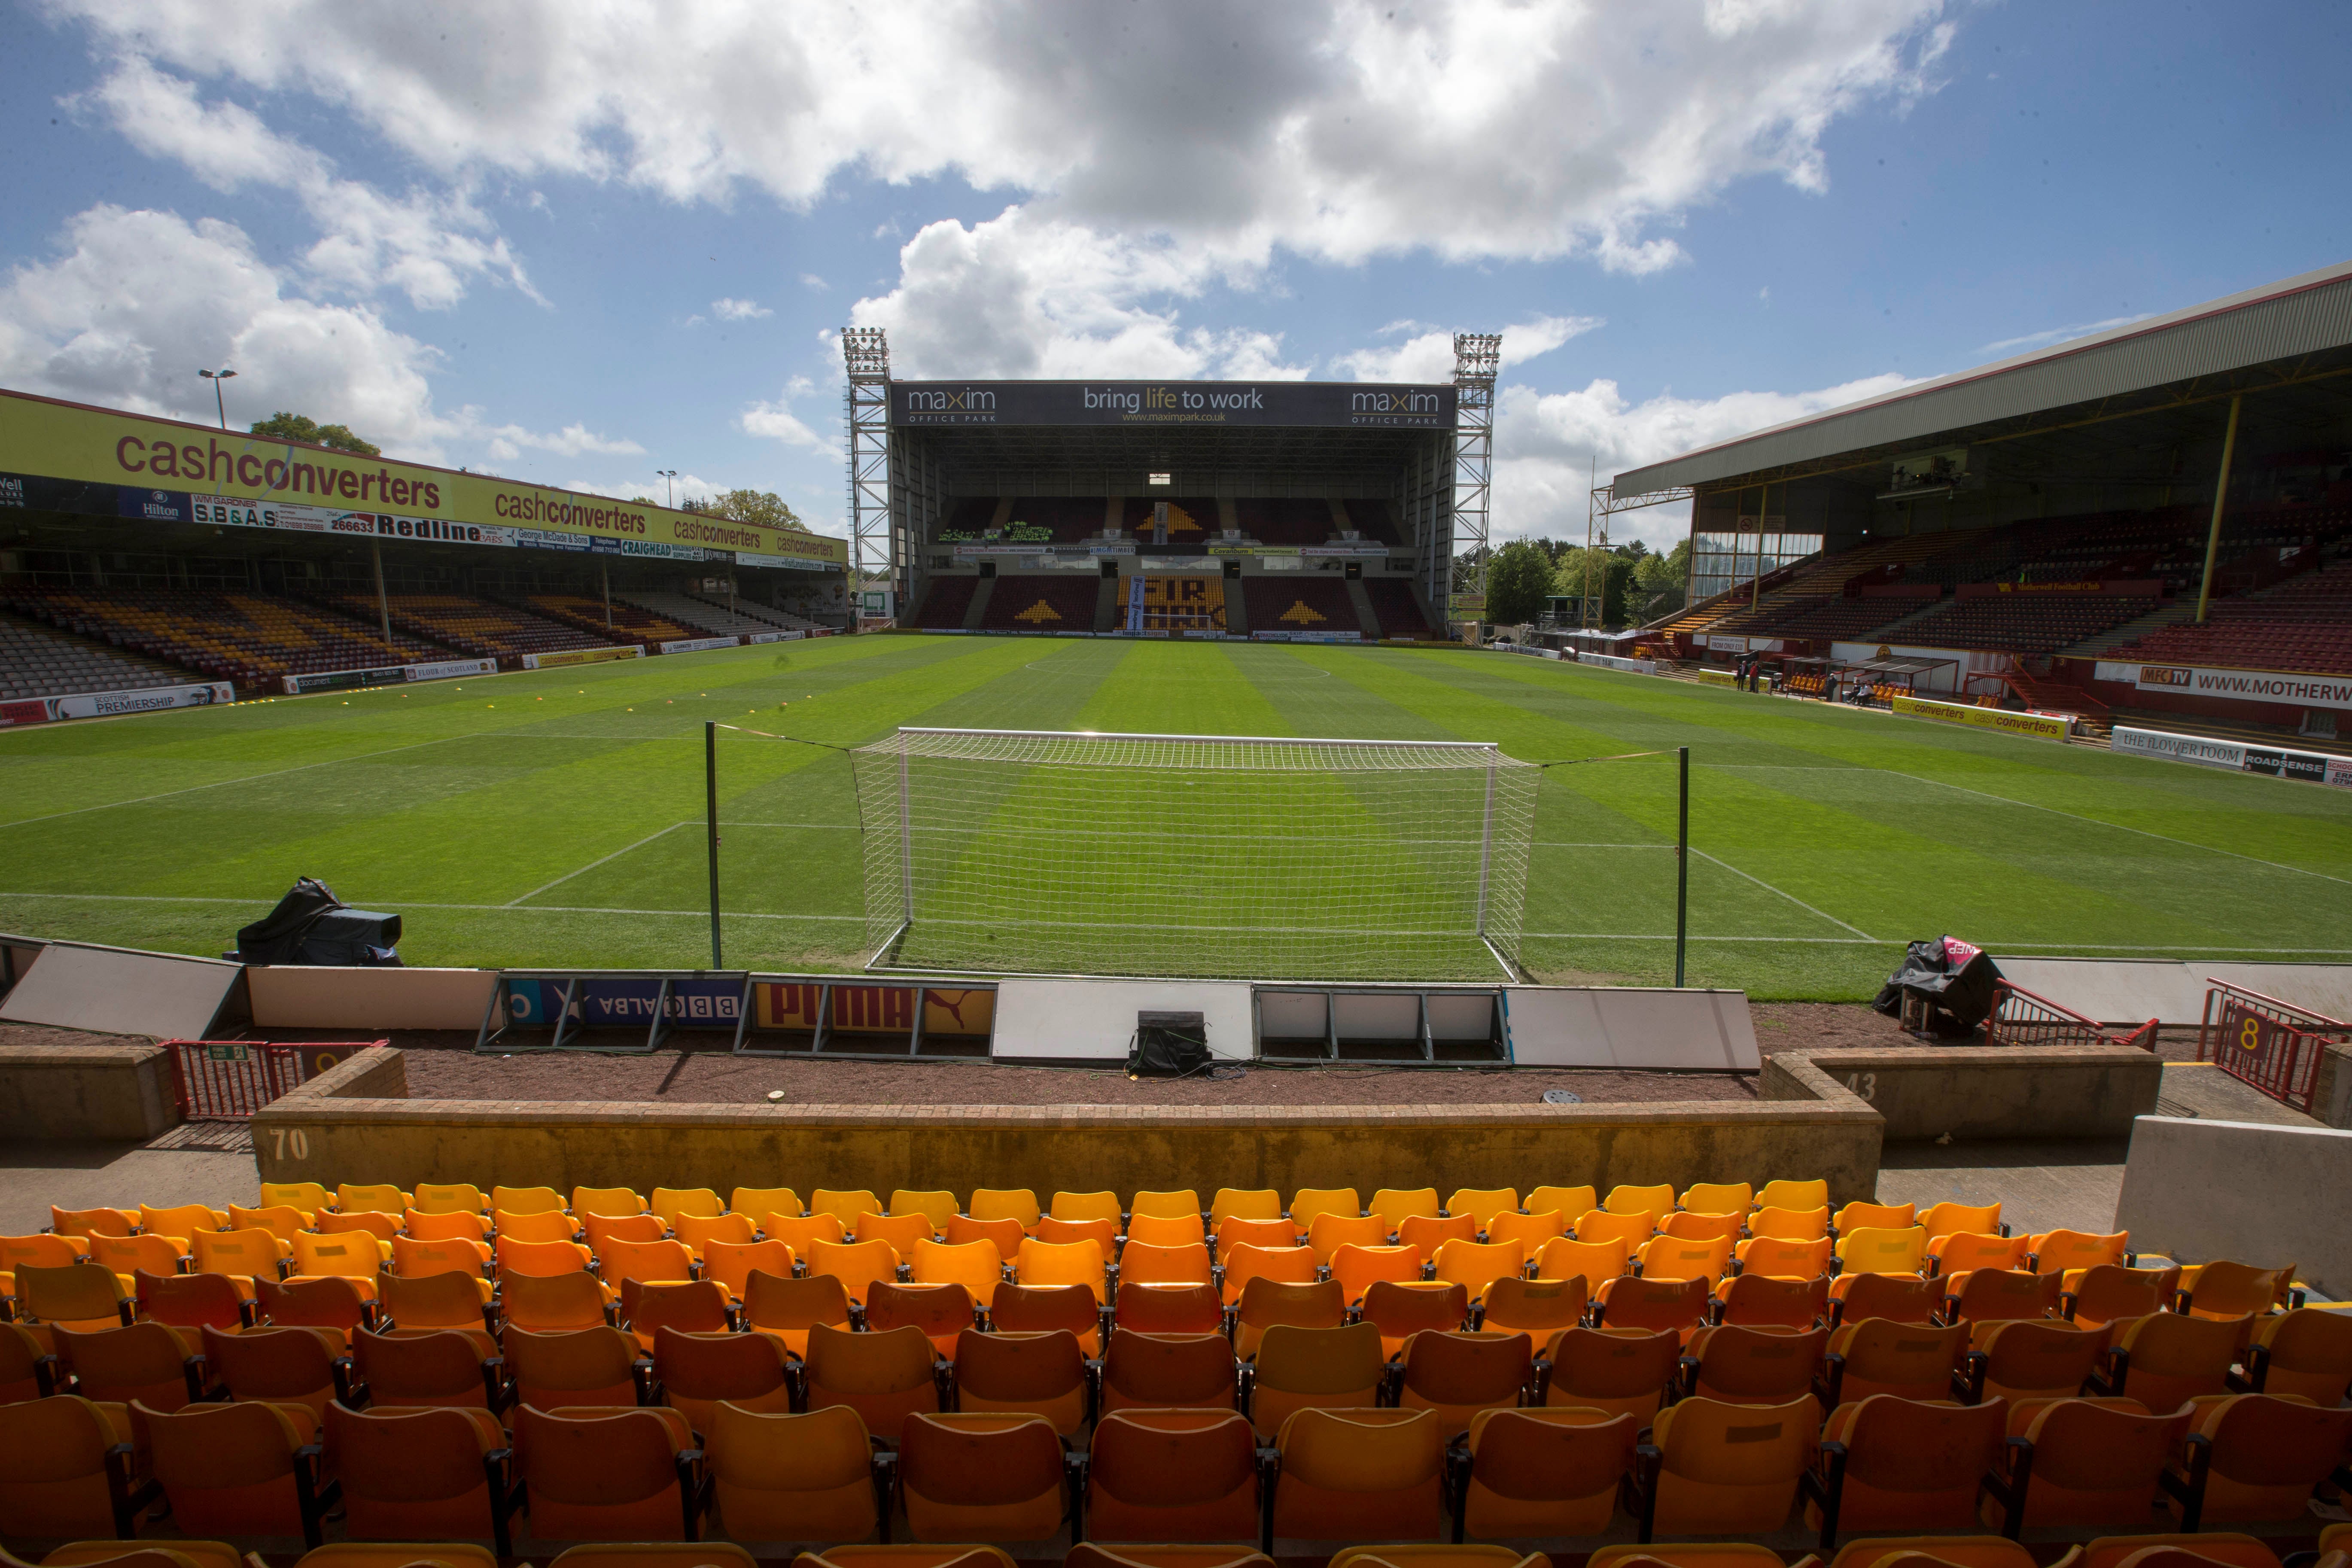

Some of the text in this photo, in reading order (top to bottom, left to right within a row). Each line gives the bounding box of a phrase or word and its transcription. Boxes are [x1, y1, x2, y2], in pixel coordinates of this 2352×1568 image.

[909, 387, 995, 409] maxim
[1084, 387, 1263, 414] bring life to work
[1352, 389, 1439, 412] maxim
[1122, 413, 1226, 423] www.maximpark.co.uk
[116, 435, 440, 509] cashconverters
[143, 502, 179, 516] Hilton
[194, 494, 257, 508] WM GARDNER
[495, 492, 645, 533] cashconverters
[331, 520, 374, 533] 266633
[377, 514, 481, 542] Redline
[674, 518, 760, 548] cashconverters
[478, 534, 503, 544] CABS
[519, 528, 542, 542] George
[543, 531, 567, 542] McDade
[574, 536, 588, 544] Sons
[595, 537, 617, 546] Telephone
[623, 541, 671, 556] CRAIGHEAD
[672, 544, 691, 552] BUILDING
[777, 534, 833, 557] cashconverters
[2017, 582, 2052, 591] Motherwell
[2083, 581, 2099, 590] Club
[541, 654, 584, 665] cashconverters
[593, 649, 630, 660] cashconverters
[418, 668, 439, 676] FLOUR
[447, 664, 478, 673] SCOTLAND
[2143, 669, 2188, 684] MFC TV
[246, 680, 255, 688] 13
[94, 694, 129, 703] SCOTTISH
[97, 697, 174, 713] PREMIERSHIP
[3, 704, 39, 712] SKIP
[4, 709, 39, 718] HIRE
[1896, 699, 1964, 719] cashconverters
[1975, 711, 2058, 734] cashconverters
[2246, 755, 2324, 773] ROADSENSE
[599, 998, 661, 1015] ALBA
[770, 983, 913, 1028] PUMA
[2241, 1017, 2259, 1050] 8
[1847, 1073, 1876, 1101] 43
[269, 1129, 308, 1160] 70
